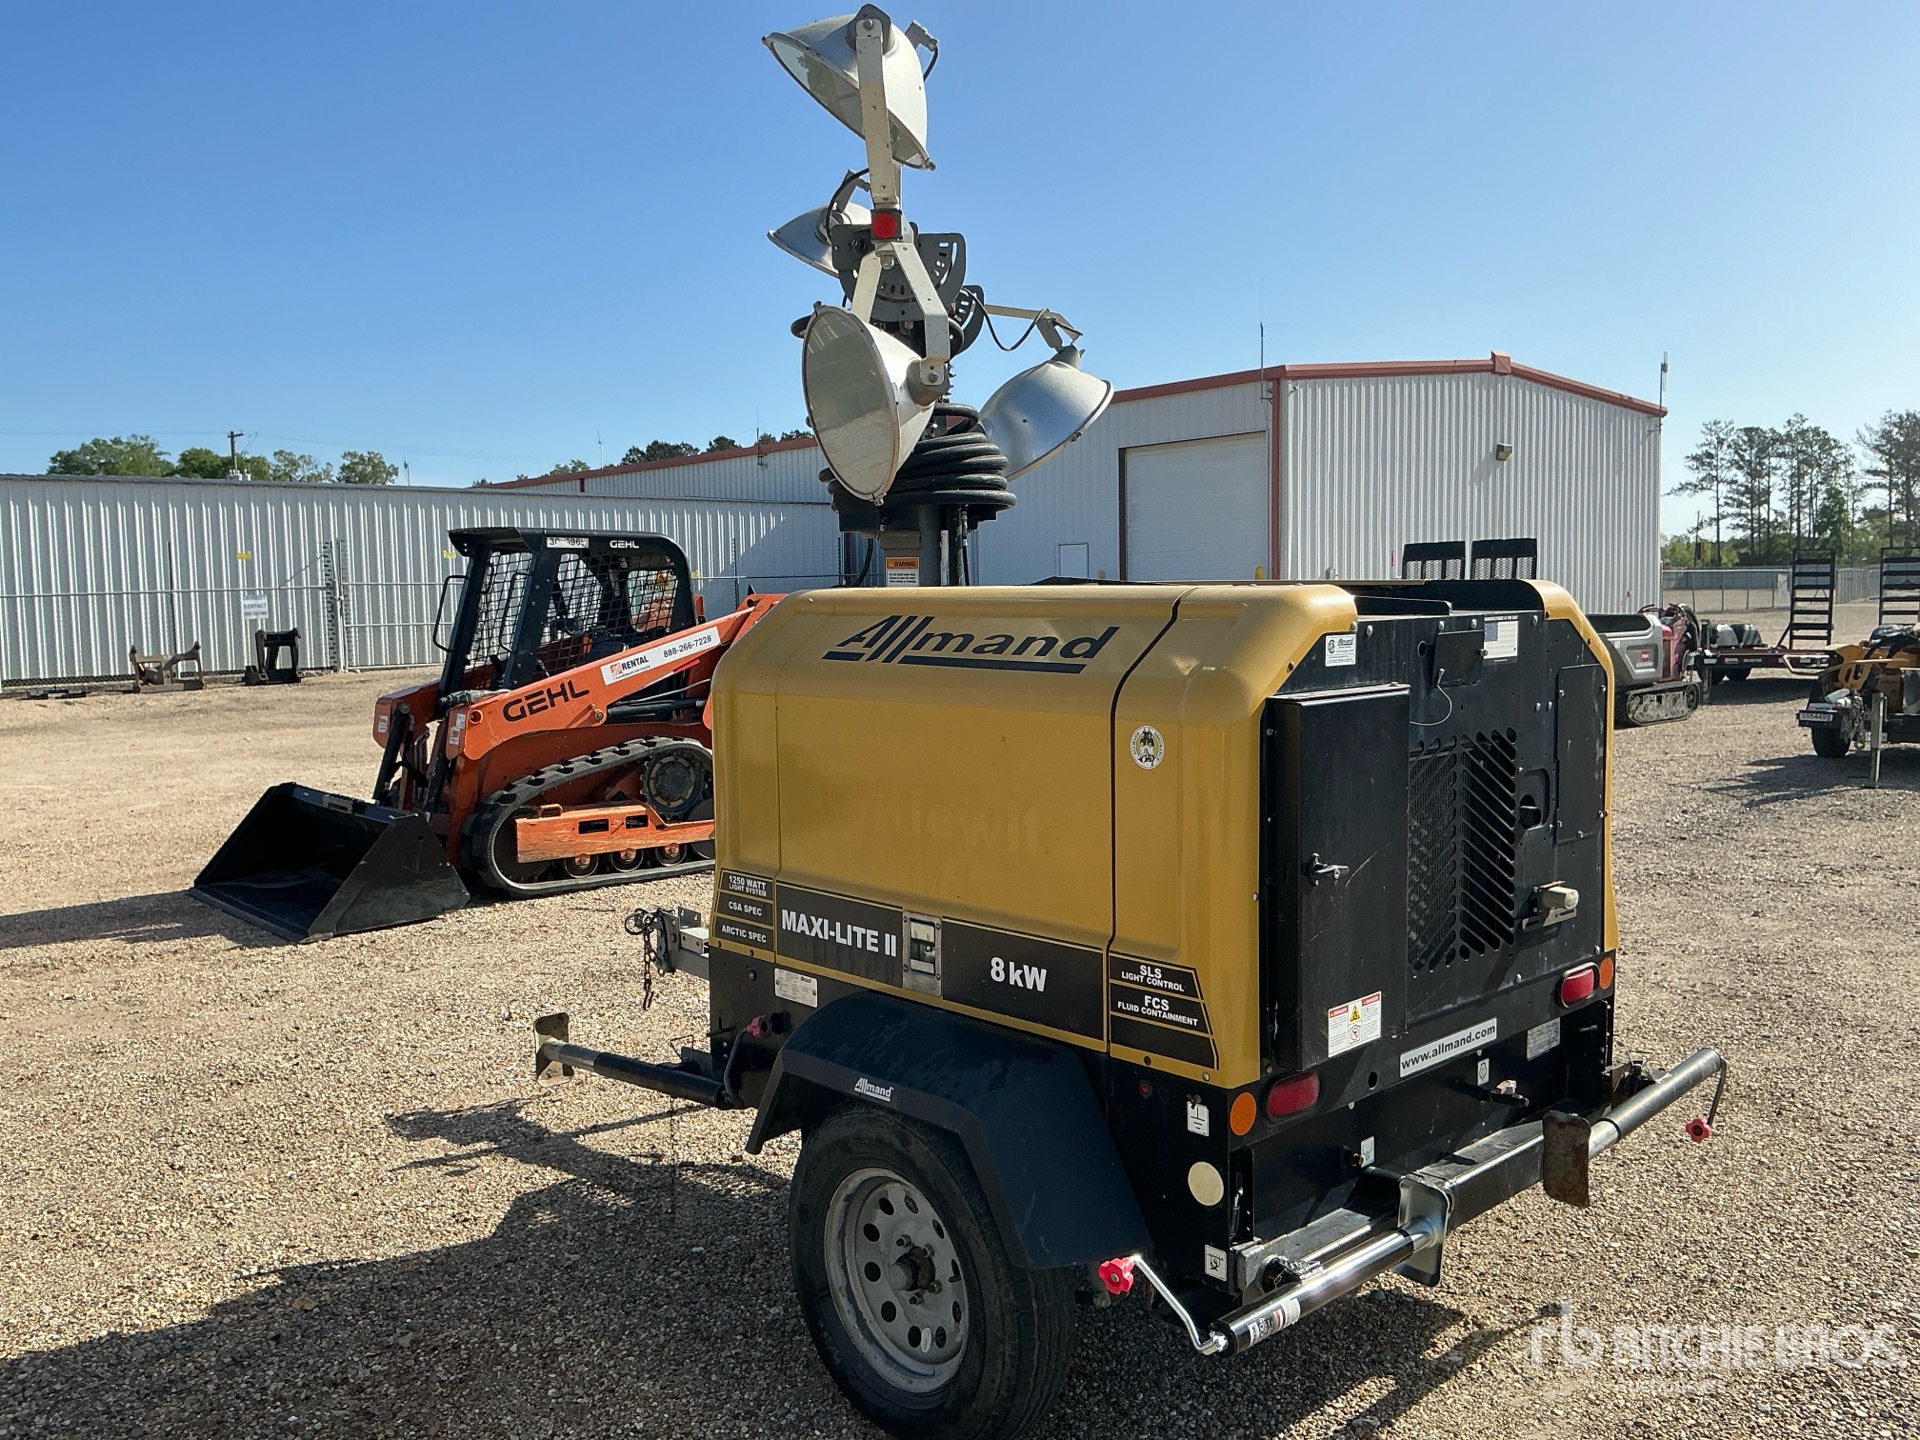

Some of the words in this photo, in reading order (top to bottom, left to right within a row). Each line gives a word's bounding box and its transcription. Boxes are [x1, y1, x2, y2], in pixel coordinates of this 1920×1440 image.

[609, 540, 639, 549] GEHL
[663, 634, 712, 658] 888-266-7228
[824, 614, 1121, 670] Allmand
[621, 655, 650, 671] RENTAL
[502, 679, 590, 722] GEHL
[728, 874, 745, 886] 1250
[746, 878, 767, 891] WATT
[728, 883, 745, 892] LIGHT
[745, 886, 767, 897] SYSTEM
[728, 901, 743, 912] CSA
[743, 904, 762, 916] SPEC
[721, 924, 747, 938] ARCTIC
[748, 930, 767, 943] SPEC
[782, 909, 879, 953] MAXI-LITE
[885, 933, 897, 957] II
[990, 956, 1006, 982] 8
[1009, 961, 1047, 992] kW
[1121, 971, 1145, 982] LIGHT
[1146, 977, 1185, 992] CONTROL
[1140, 964, 1162, 979] SLS
[1144, 995, 1170, 1011] FCS
[1117, 1001, 1139, 1012] FLUID
[1141, 1007, 1199, 1026] CONTAINMENT
[1401, 1024, 1496, 1070] www.allmand.com
